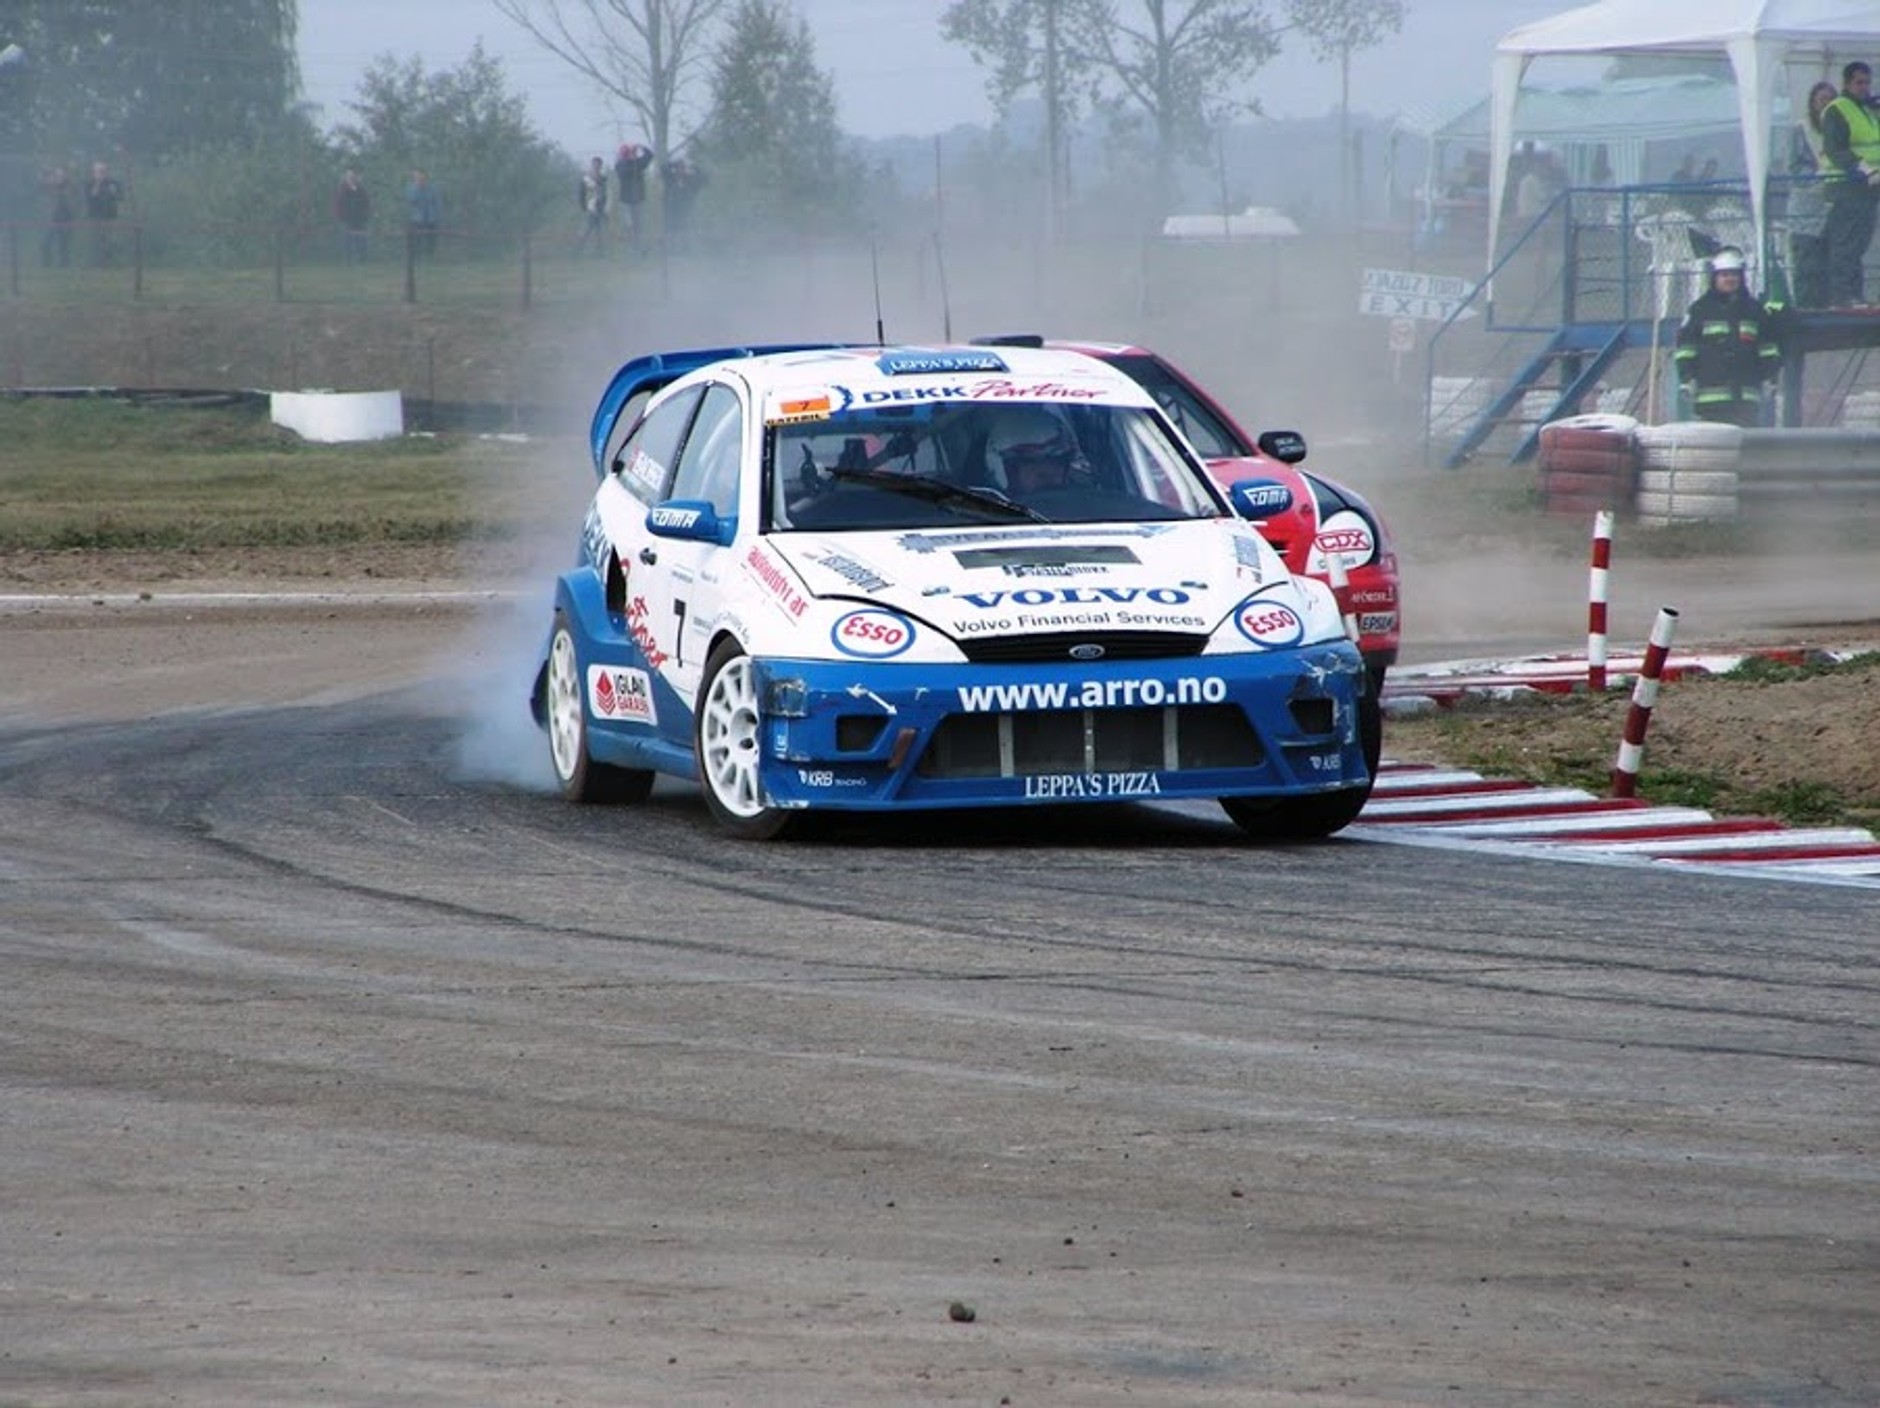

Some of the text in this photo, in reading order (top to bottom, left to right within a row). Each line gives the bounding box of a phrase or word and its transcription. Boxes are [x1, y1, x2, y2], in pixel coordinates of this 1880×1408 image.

[1369, 296, 1456, 318] EXIT
[863, 379, 1107, 402] DEKK Partner
[800, 400, 809, 411] 7
[1319, 533, 1370, 549] CDX
[955, 587, 1190, 608] VOLVO
[674, 598, 686, 667] 7
[953, 610, 1206, 633] Volvo Financial Services
[958, 675, 1226, 712] www.arro.no
[1025, 772, 1161, 798] LEPPA'S PIZZA
